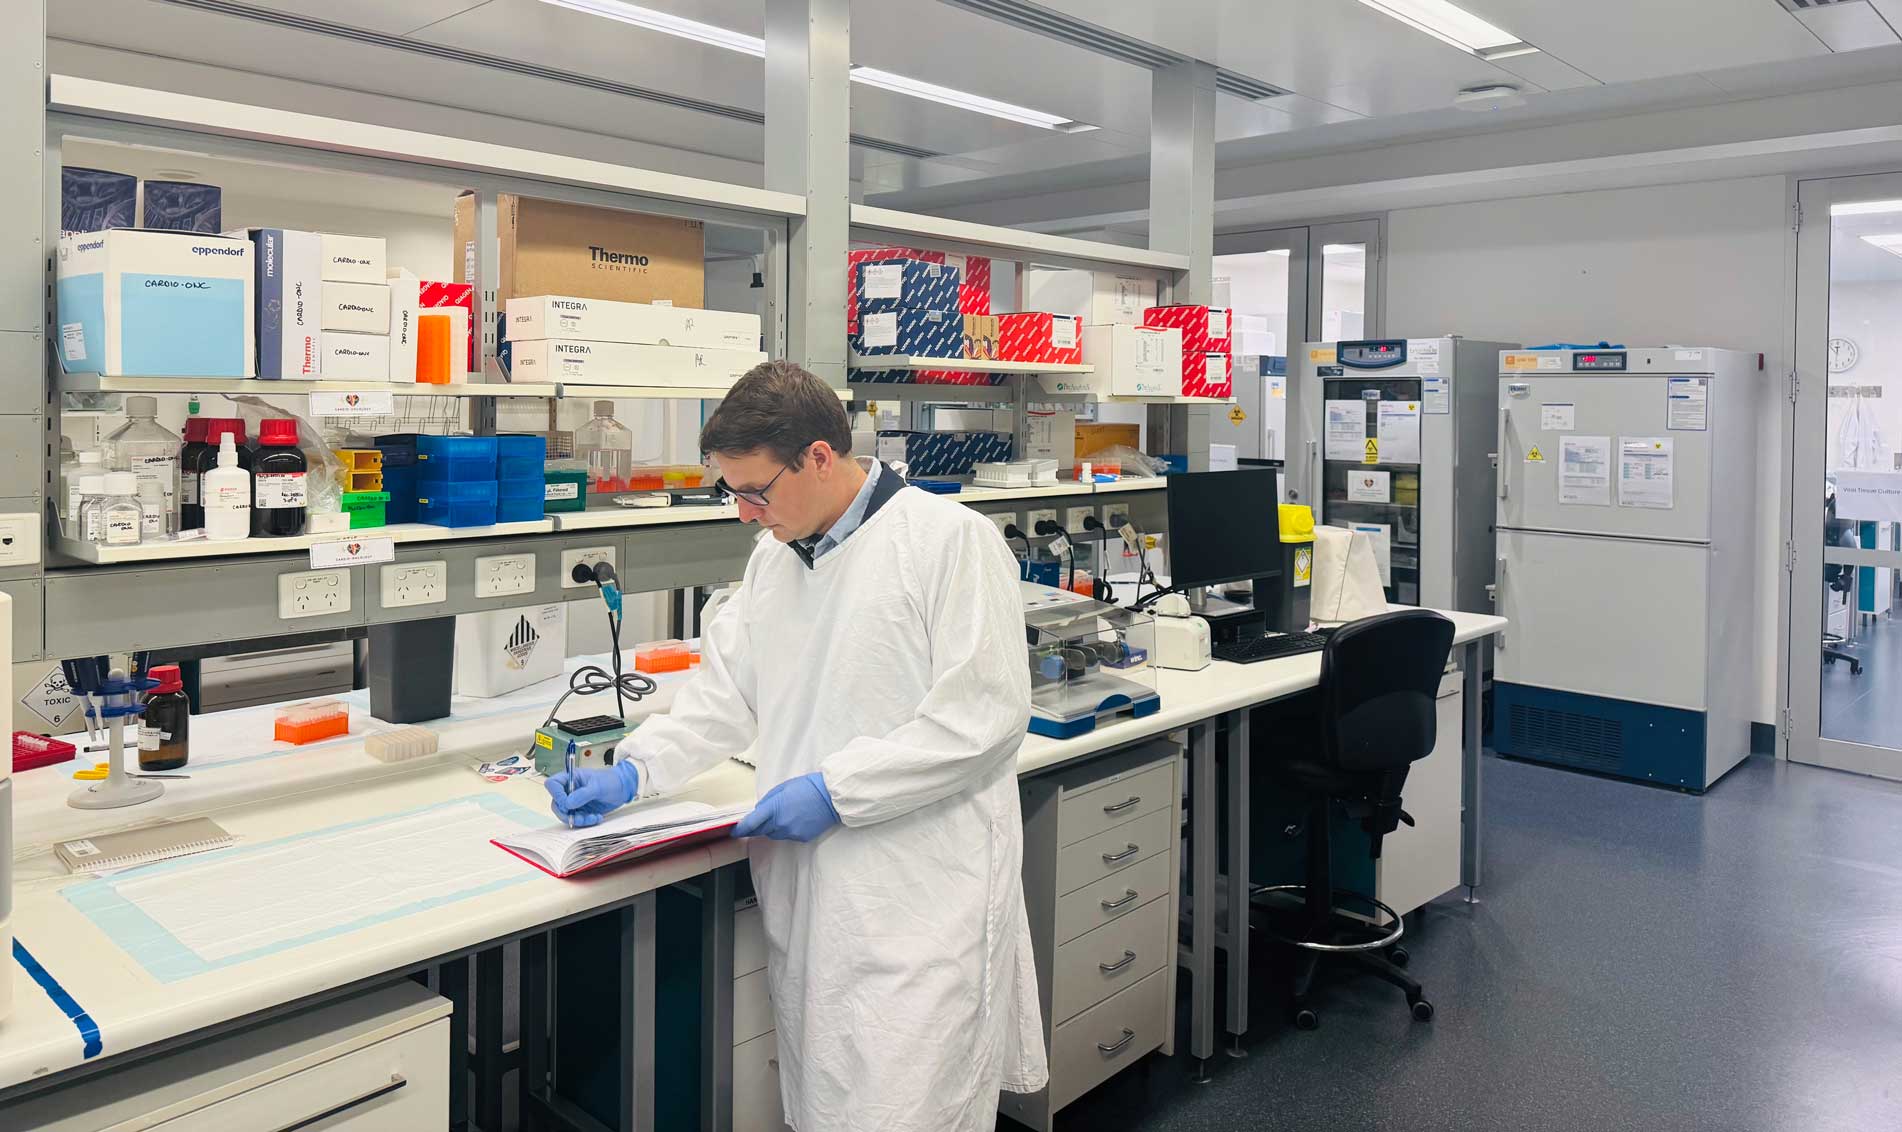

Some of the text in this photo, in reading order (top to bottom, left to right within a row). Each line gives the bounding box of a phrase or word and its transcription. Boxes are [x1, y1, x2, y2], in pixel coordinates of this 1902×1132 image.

[191, 246, 245, 257] eppendorf
[267, 234, 275, 277] molecular
[588, 246, 649, 266] Thermo
[591, 263, 648, 274] SCIENTIFIC
[551, 300, 588, 312] INTEGRA
[555, 344, 592, 354] INTEGRA
[302, 336, 312, 375] Thermo
[44, 696, 71, 706] TOXIC
[54, 715, 61, 723] 6
